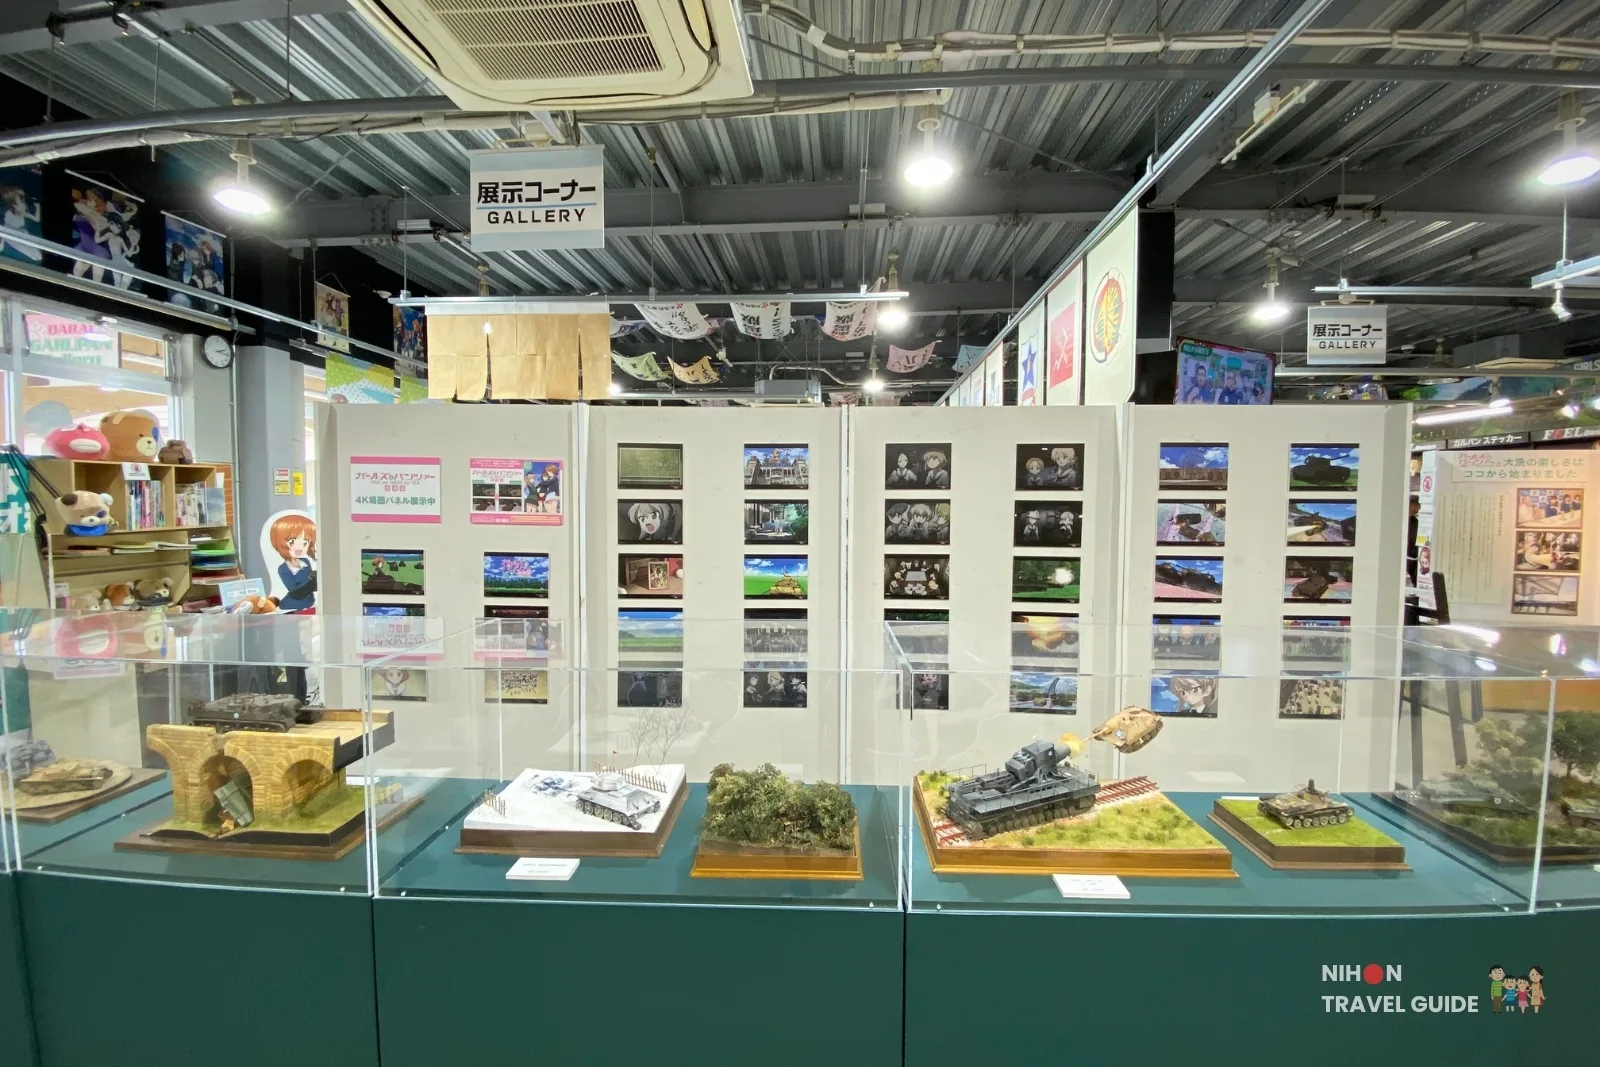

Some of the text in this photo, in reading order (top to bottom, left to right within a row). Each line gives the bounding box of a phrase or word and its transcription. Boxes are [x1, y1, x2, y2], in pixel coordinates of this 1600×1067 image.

[477, 179, 596, 204] 展示コーナー
[487, 208, 586, 224] GALLERY
[1312, 323, 1383, 337] 展示コーナー
[1318, 340, 1377, 349] GALLERY
[1453, 435, 1522, 447] ガルパン ステッカー
[1464, 470, 1577, 478] ココから始まりました
